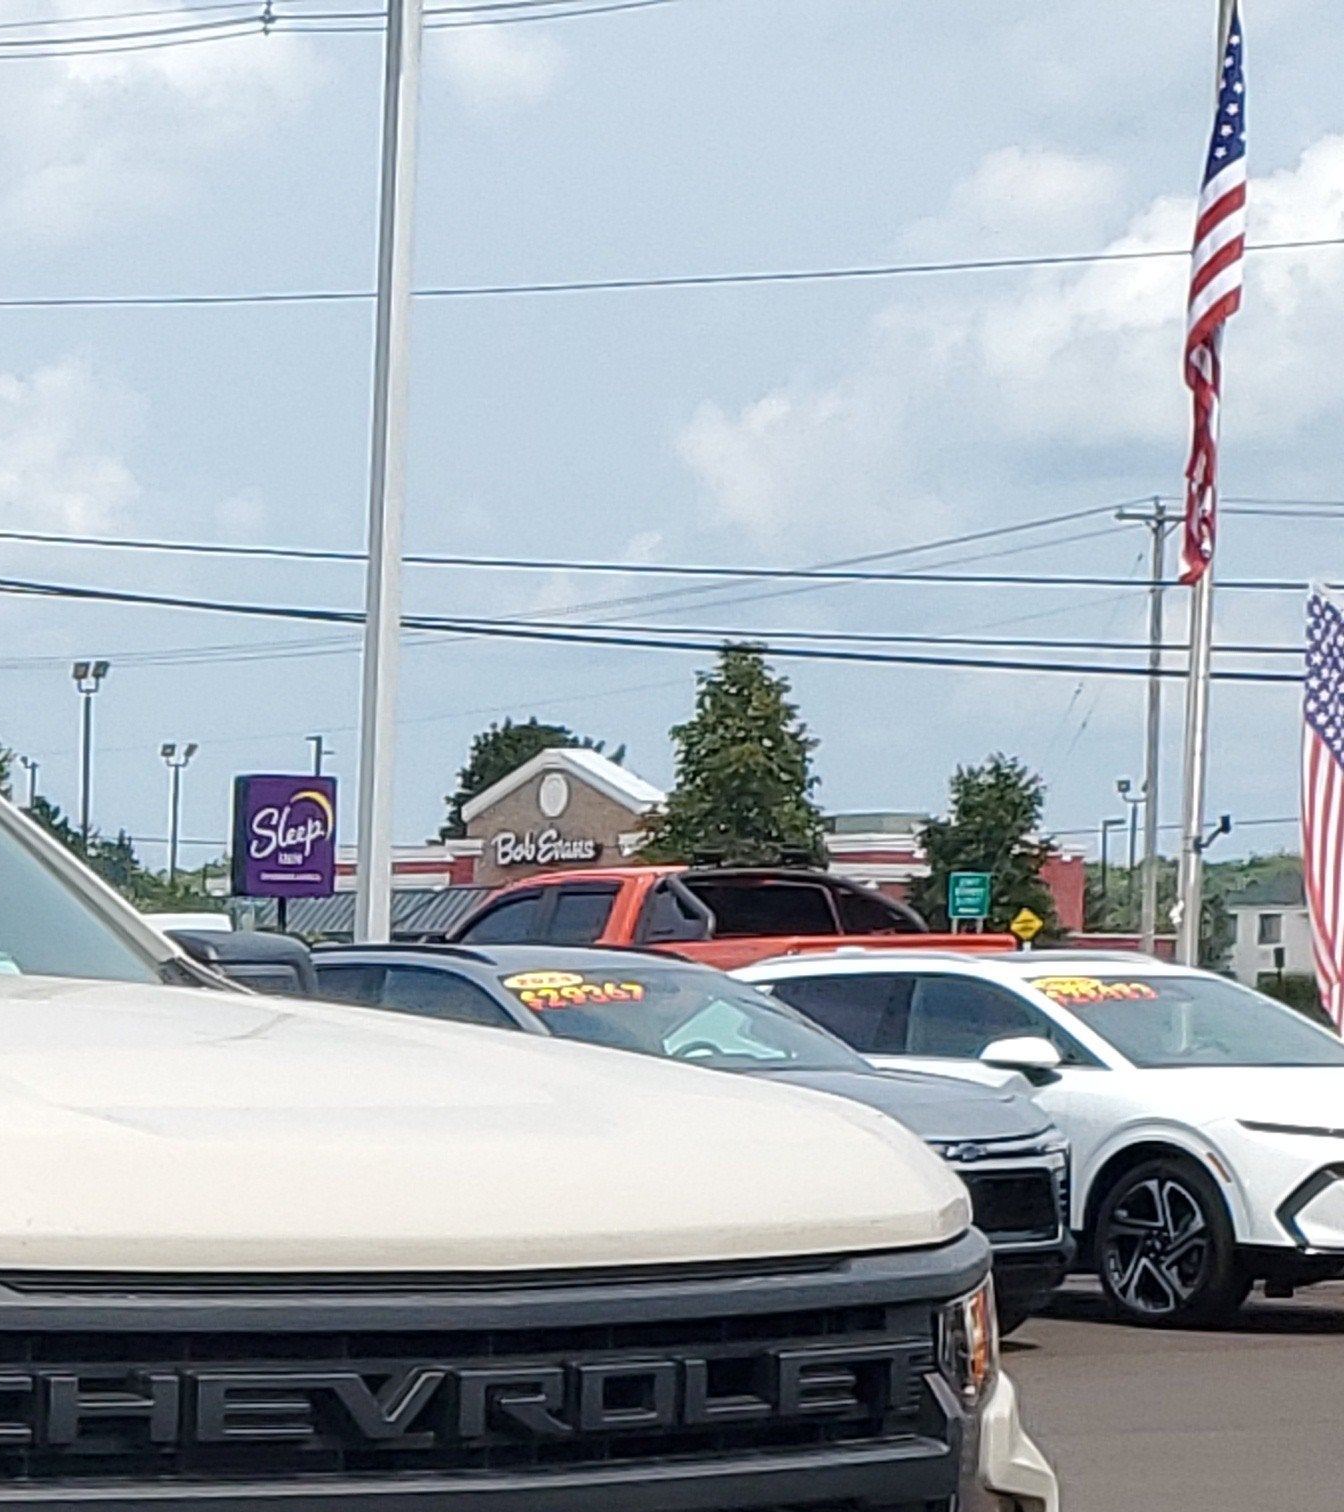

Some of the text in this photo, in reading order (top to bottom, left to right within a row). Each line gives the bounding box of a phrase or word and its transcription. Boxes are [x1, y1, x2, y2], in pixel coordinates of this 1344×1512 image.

[250, 806, 325, 858] Sleep
[491, 828, 596, 865] Bob Evans
